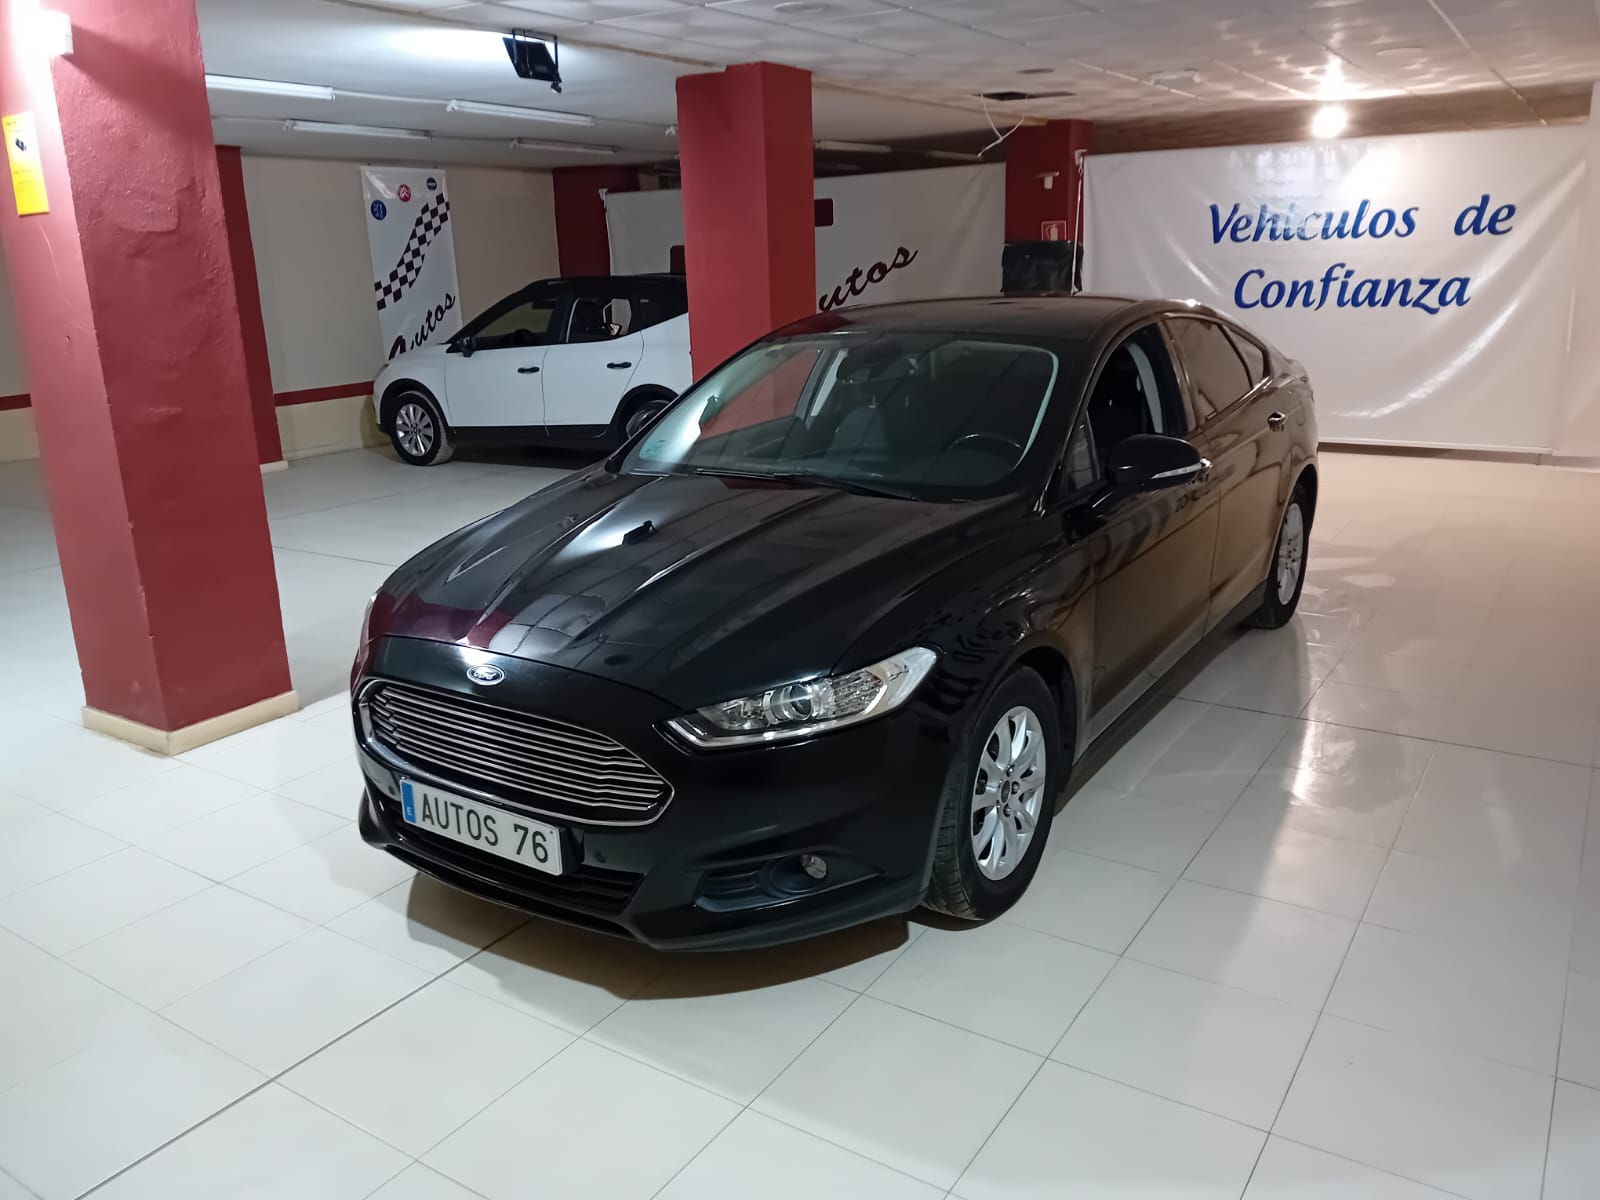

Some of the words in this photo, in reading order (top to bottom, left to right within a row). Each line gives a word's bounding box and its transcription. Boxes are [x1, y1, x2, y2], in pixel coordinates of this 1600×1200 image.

[1453, 194, 1516, 236] de
[816, 246, 918, 311] utos
[1234, 262, 1471, 315] Confianza
[471, 667, 500, 681] Ford
[422, 793, 499, 847] AUTOS
[513, 823, 549, 864] 76
